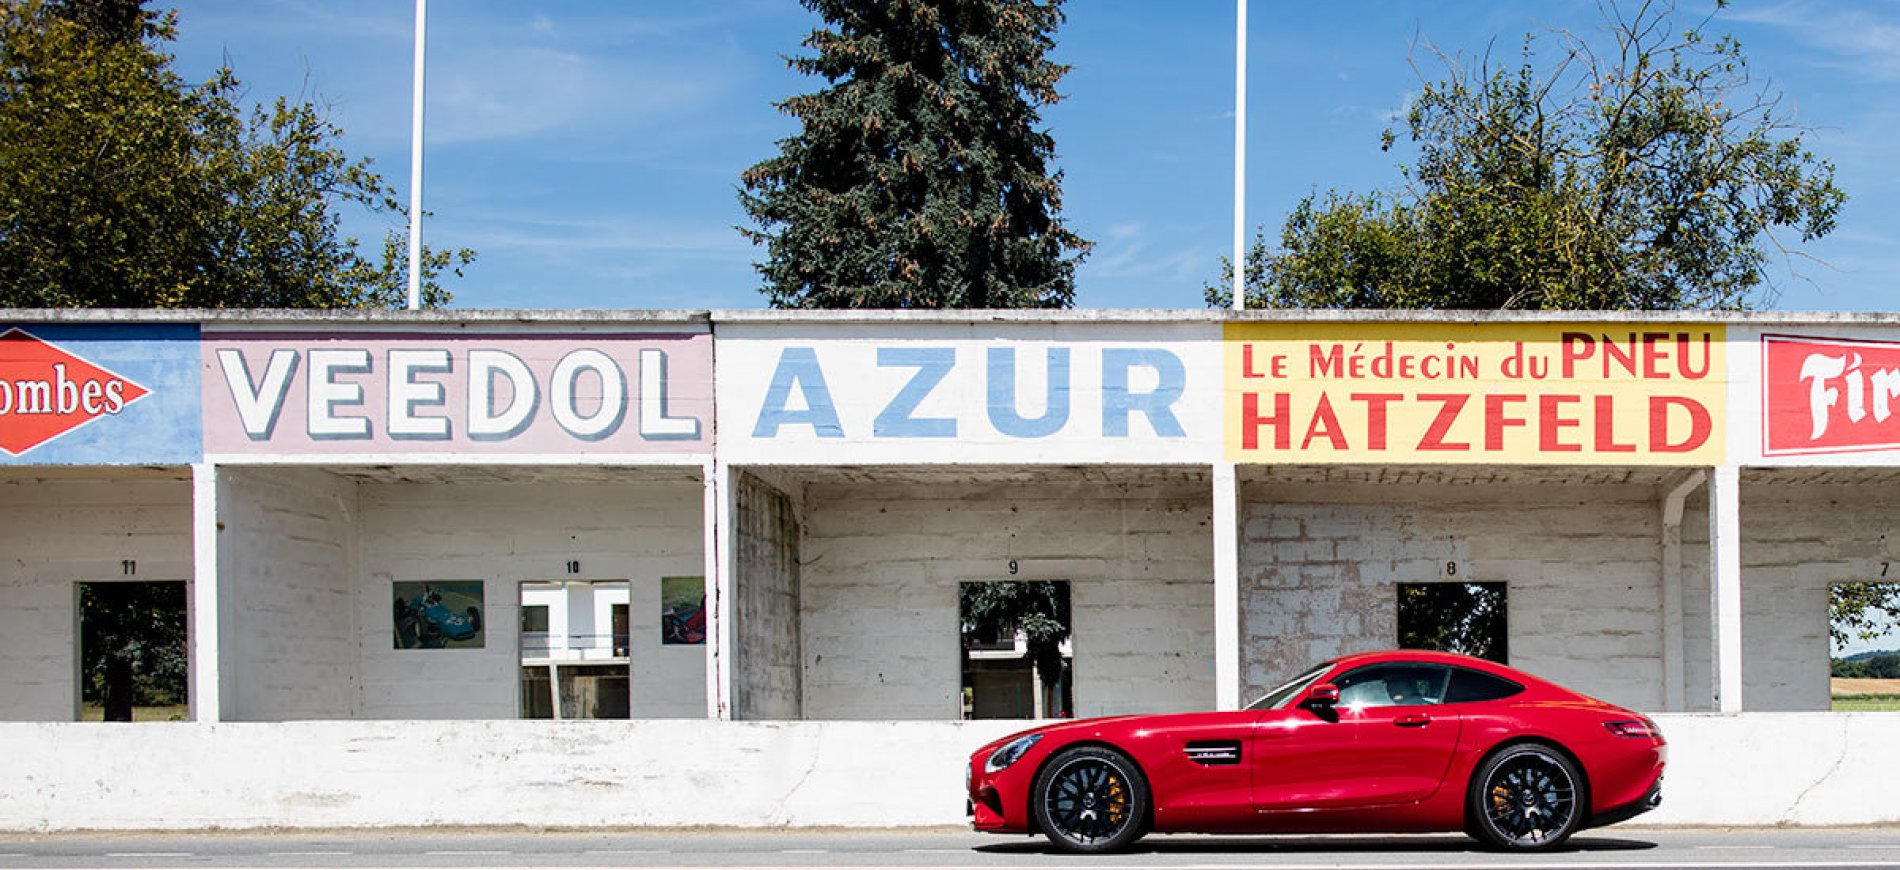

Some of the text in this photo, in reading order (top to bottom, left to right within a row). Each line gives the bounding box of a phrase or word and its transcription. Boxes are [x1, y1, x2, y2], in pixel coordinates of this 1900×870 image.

[1500, 341, 1548, 379] du
[1561, 332, 1711, 380] PNEU
[216, 348, 702, 441] VEEDOL
[751, 347, 1187, 438] AZUR
[1241, 390, 1713, 453] HATZFELD
[121, 560, 136, 575] 11
[566, 560, 579, 574] 10
[1008, 560, 1018, 574] 9
[1446, 561, 1456, 576] 8
[1880, 562, 1890, 576] 7
